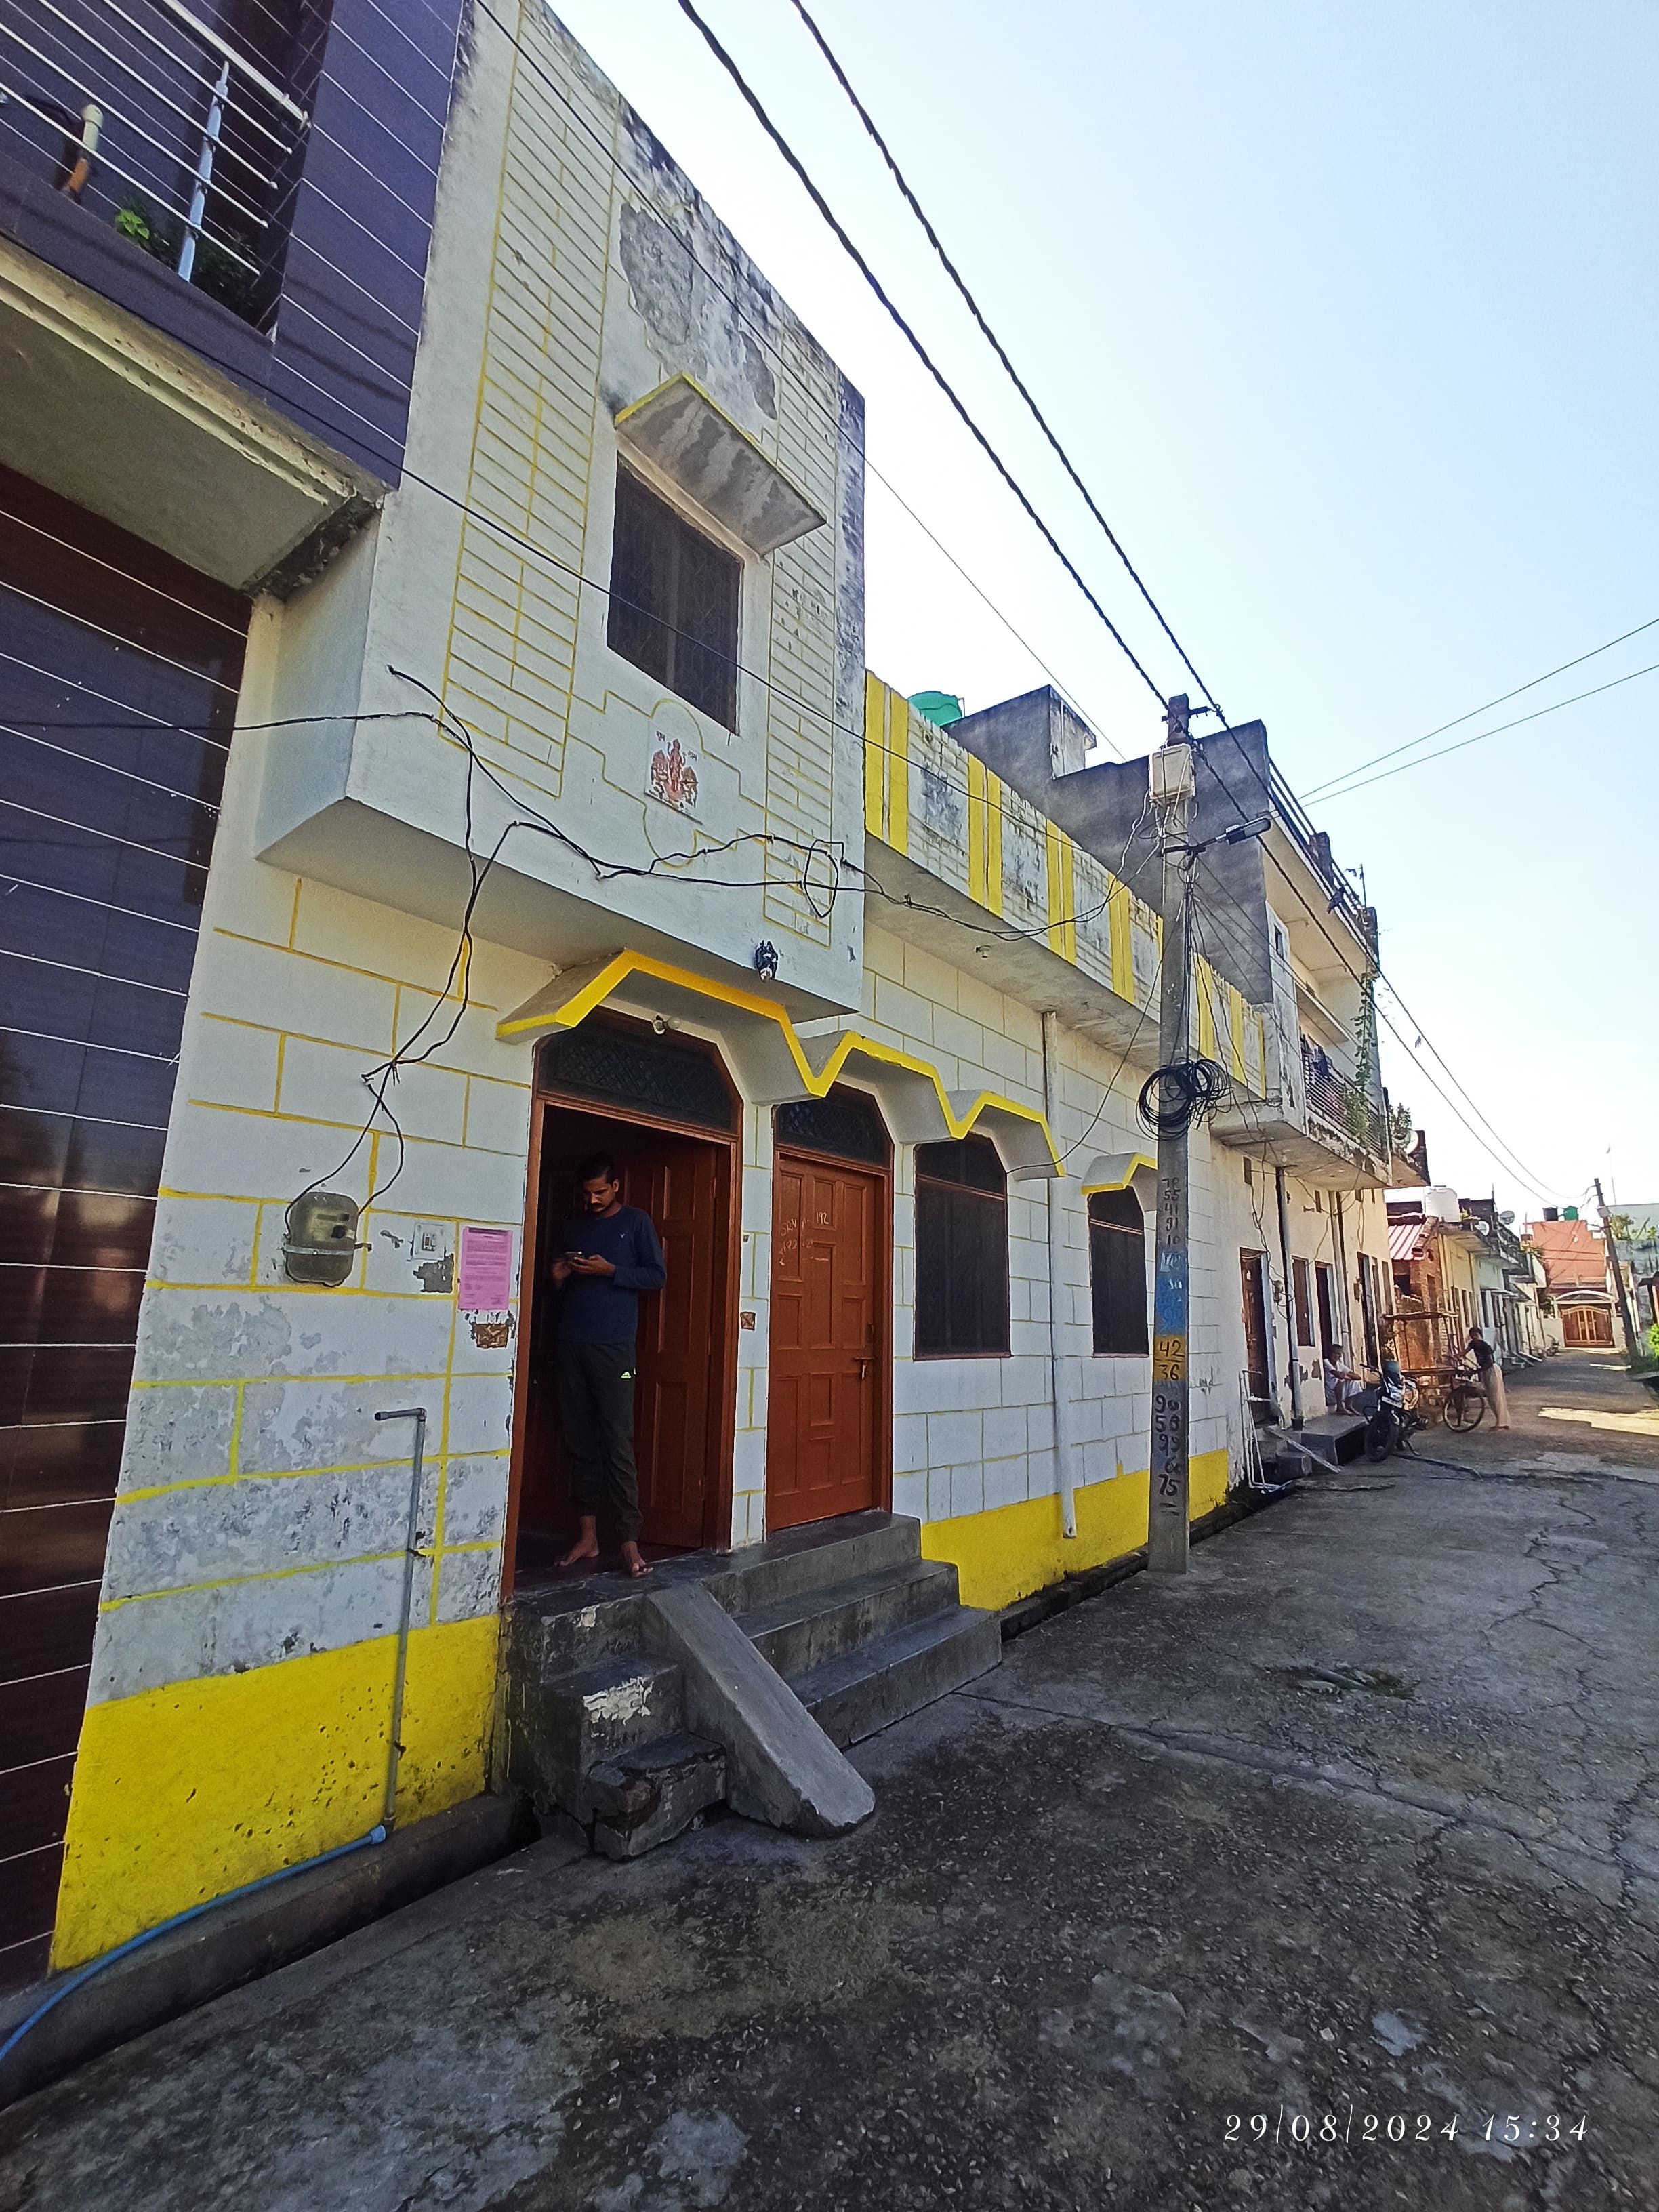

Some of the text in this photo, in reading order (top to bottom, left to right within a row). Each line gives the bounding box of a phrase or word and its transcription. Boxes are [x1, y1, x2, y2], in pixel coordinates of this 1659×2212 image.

[1163, 1189, 1181, 1201] 55
[1160, 1340, 1185, 1357] 42
[1159, 1364, 1180, 1380] 36
[1158, 1473, 1181, 1496] 75
